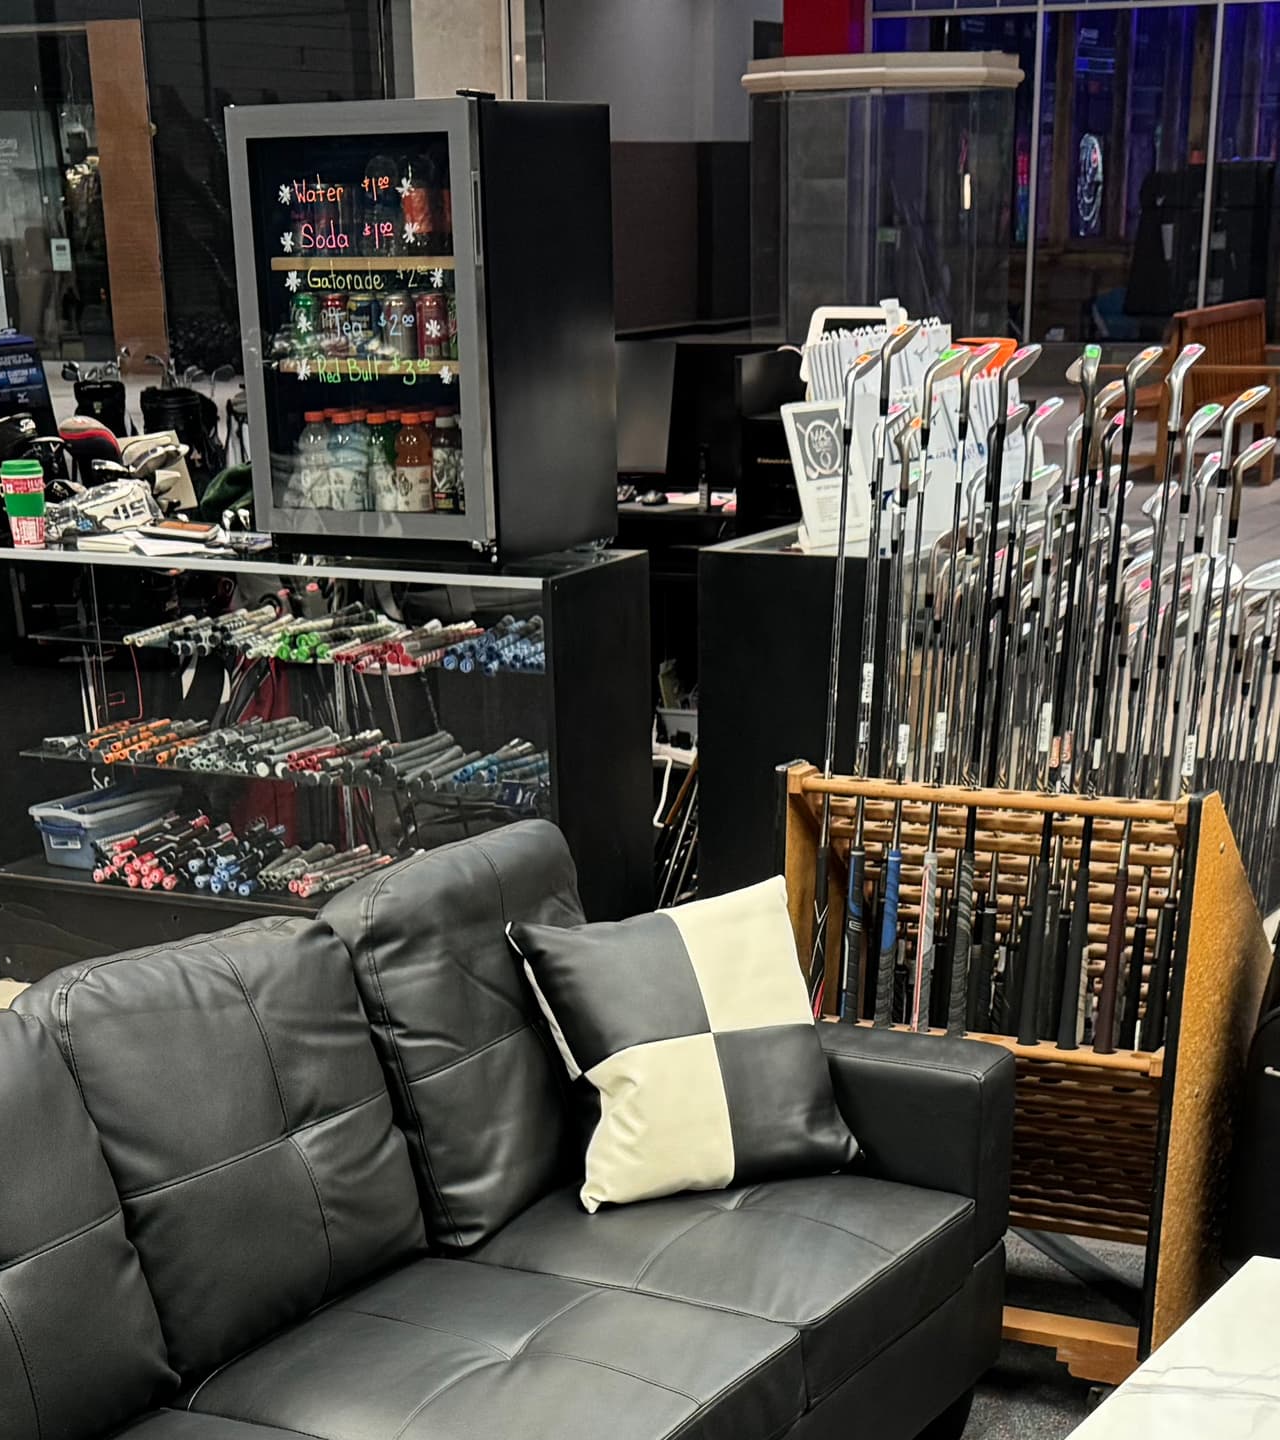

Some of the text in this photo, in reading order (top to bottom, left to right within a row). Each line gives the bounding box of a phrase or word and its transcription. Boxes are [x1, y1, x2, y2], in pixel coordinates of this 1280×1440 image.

[293, 174, 344, 204] Water
[301, 219, 350, 249] Soda
[307, 259, 385, 290] Gatorade
[330, 309, 364, 340] Tea
[315, 353, 342, 384] Red
